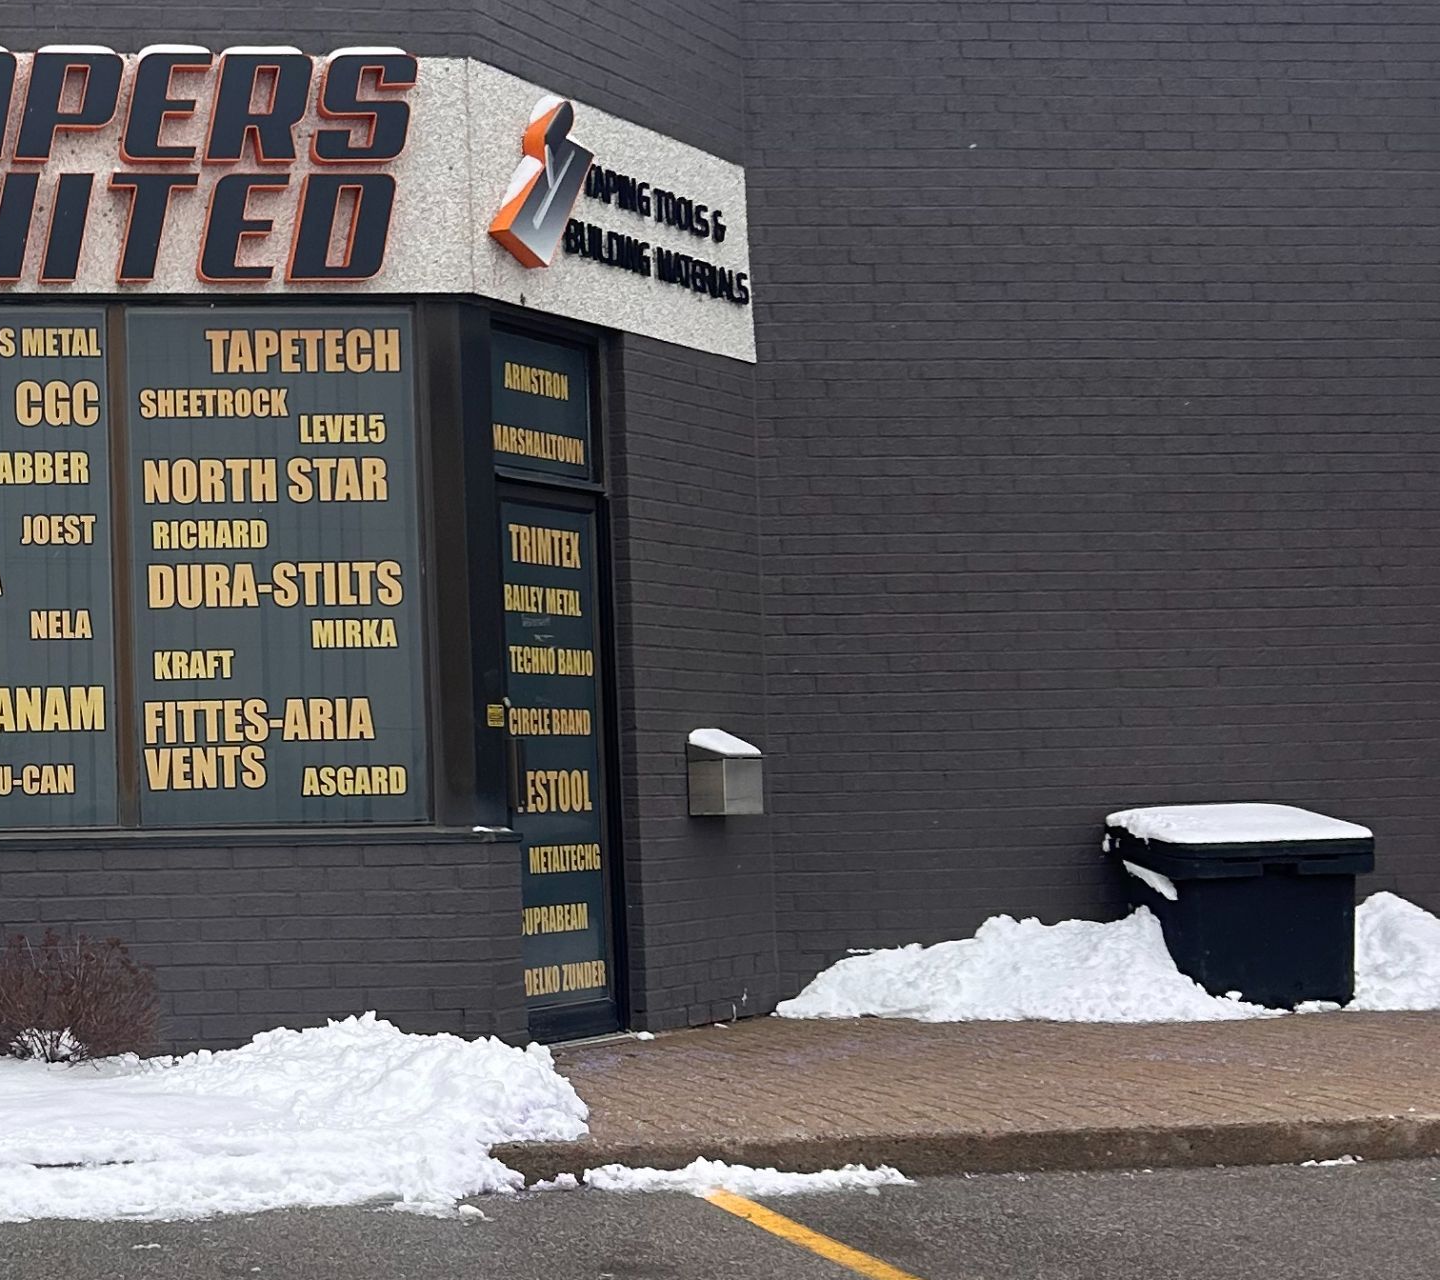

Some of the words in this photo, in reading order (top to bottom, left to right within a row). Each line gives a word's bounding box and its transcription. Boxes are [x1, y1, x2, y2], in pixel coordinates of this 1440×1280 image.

[653, 188, 709, 238] TOOLS
[711, 210, 727, 243] &
[563, 218, 651, 277] BUILDING
[656, 246, 749, 305] MATERIALS
[21, 327, 102, 357] METAL
[205, 328, 401, 374] TAPETECH
[504, 361, 569, 401] ARMSTRON
[15, 380, 100, 426] CGC
[139, 388, 289, 418] SHEETROCK
[298, 414, 387, 444] LEVEL5
[492, 423, 585, 466] MARSHALLTOWN
[143, 458, 278, 504] NORTH
[286, 457, 389, 503] STAR
[21, 515, 96, 545] JOEST
[152, 519, 269, 550] RICHARD
[508, 523, 581, 569] TRIMTEX
[147, 560, 404, 609] DURA-STILTS
[504, 583, 543, 614] BAILEY
[545, 587, 582, 617] METAL
[30, 610, 92, 640] NELA
[311, 618, 399, 649] MIRKA
[153, 649, 235, 680] KRAFT
[509, 645, 556, 675] TECHNO
[558, 648, 594, 677] BANJO
[143, 697, 375, 745] FITTES-ARIA
[509, 707, 551, 735] CIRCLE
[552, 708, 591, 736] BRAND
[143, 745, 267, 791] VENTS
[302, 766, 407, 796] ASGARD
[517, 769, 593, 813] ESTOOL
[524, 965, 560, 997] DELKO
[562, 960, 606, 992] ZUNDER
